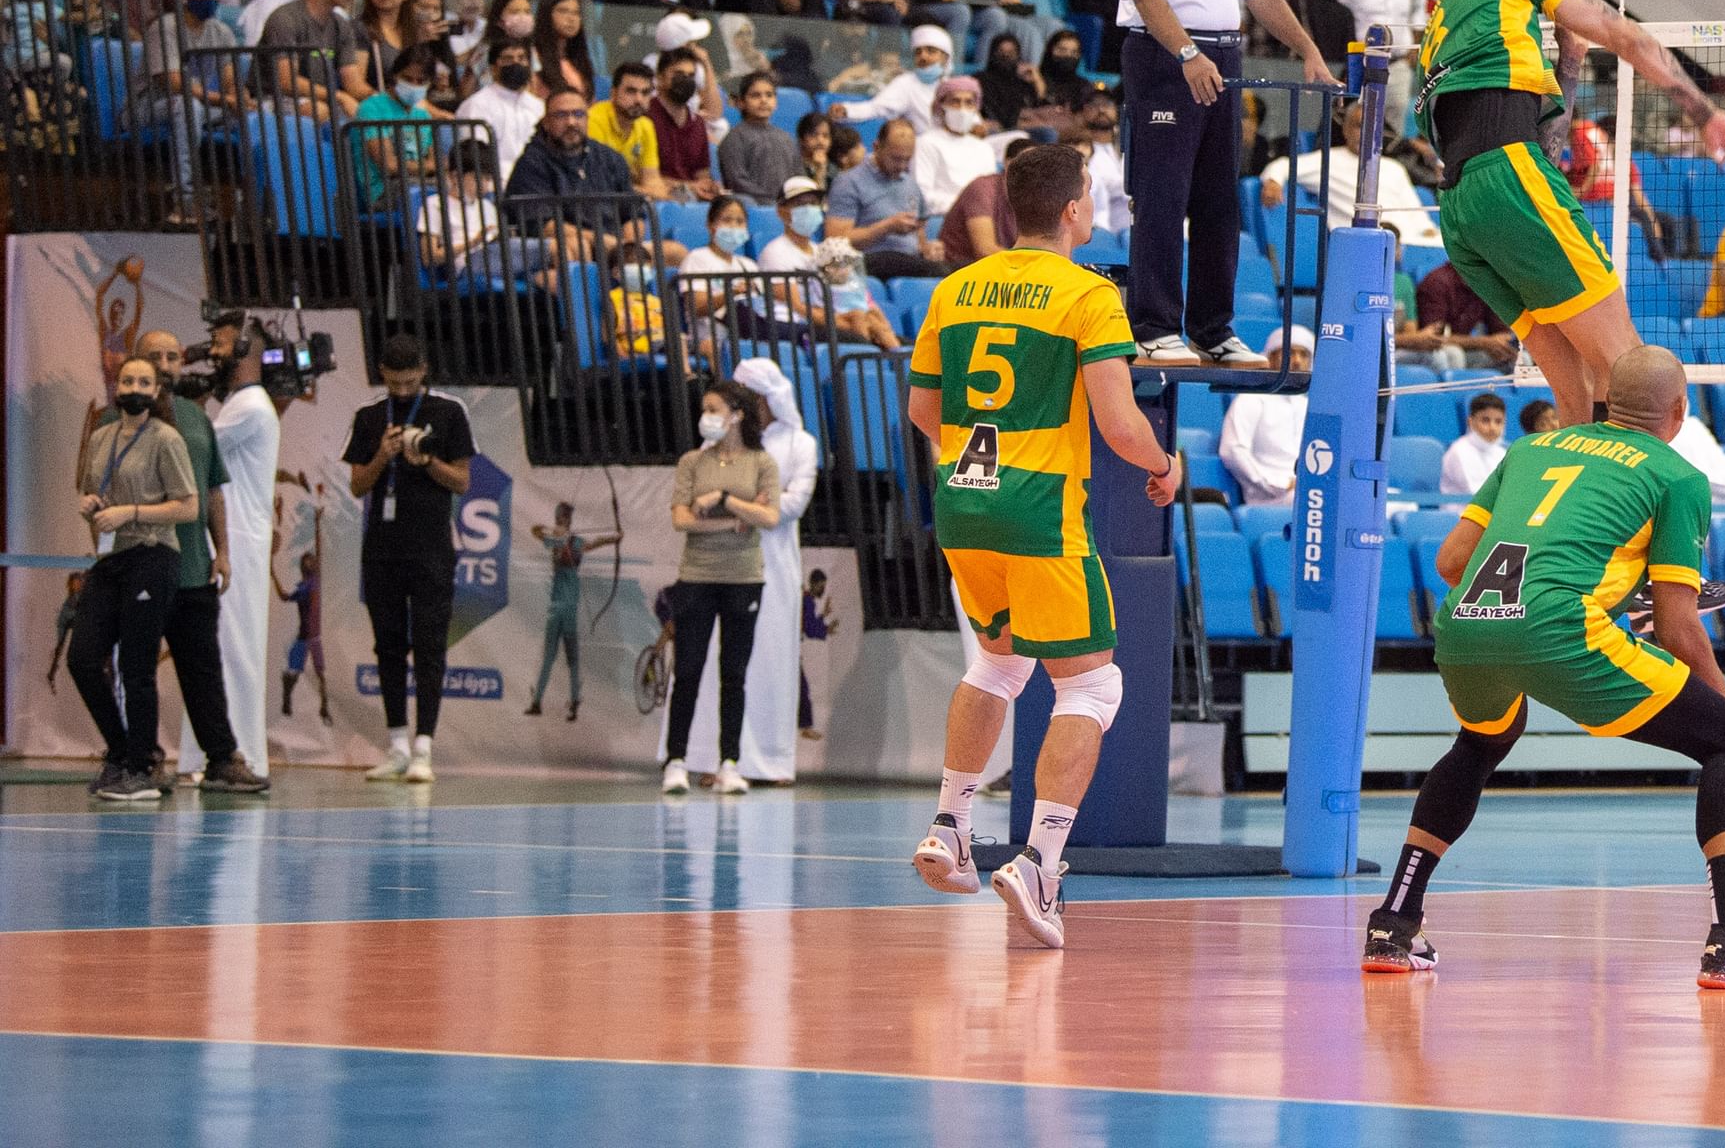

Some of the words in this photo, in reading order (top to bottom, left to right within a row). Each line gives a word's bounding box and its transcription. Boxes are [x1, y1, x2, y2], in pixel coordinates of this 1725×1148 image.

[1692, 24, 1722, 36] NAS
[955, 282, 974, 307] AL
[978, 282, 1053, 310] JAWAREH
[1368, 295, 1389, 306] FIVB
[1321, 324, 1344, 336] FIVB
[967, 327, 1016, 410] 5
[955, 423, 999, 478] A
[1531, 432, 1555, 446] AL
[1556, 434, 1648, 468] JAWAREH
[950, 476, 998, 489] ALSAYEGH
[1459, 541, 1529, 605] A
[1452, 604, 1525, 620] ALSAYEGH
